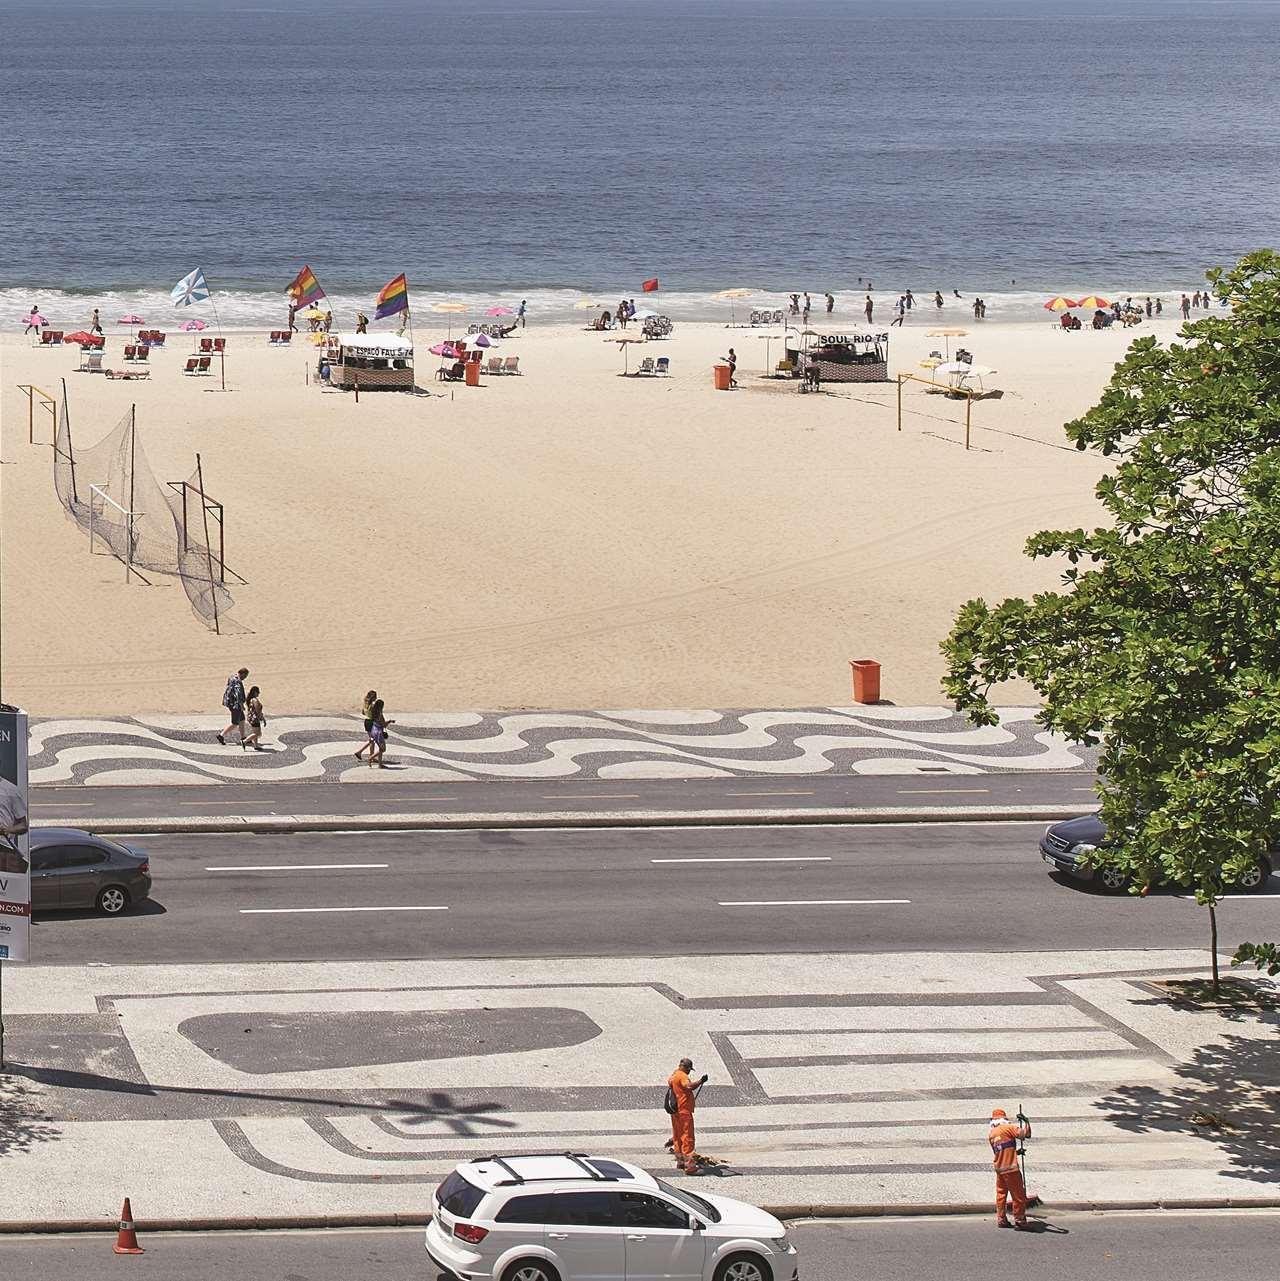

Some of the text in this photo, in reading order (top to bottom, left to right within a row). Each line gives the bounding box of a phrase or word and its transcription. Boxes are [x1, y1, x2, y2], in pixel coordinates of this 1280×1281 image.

[820, 332, 888, 344] SOUL RIO 75
